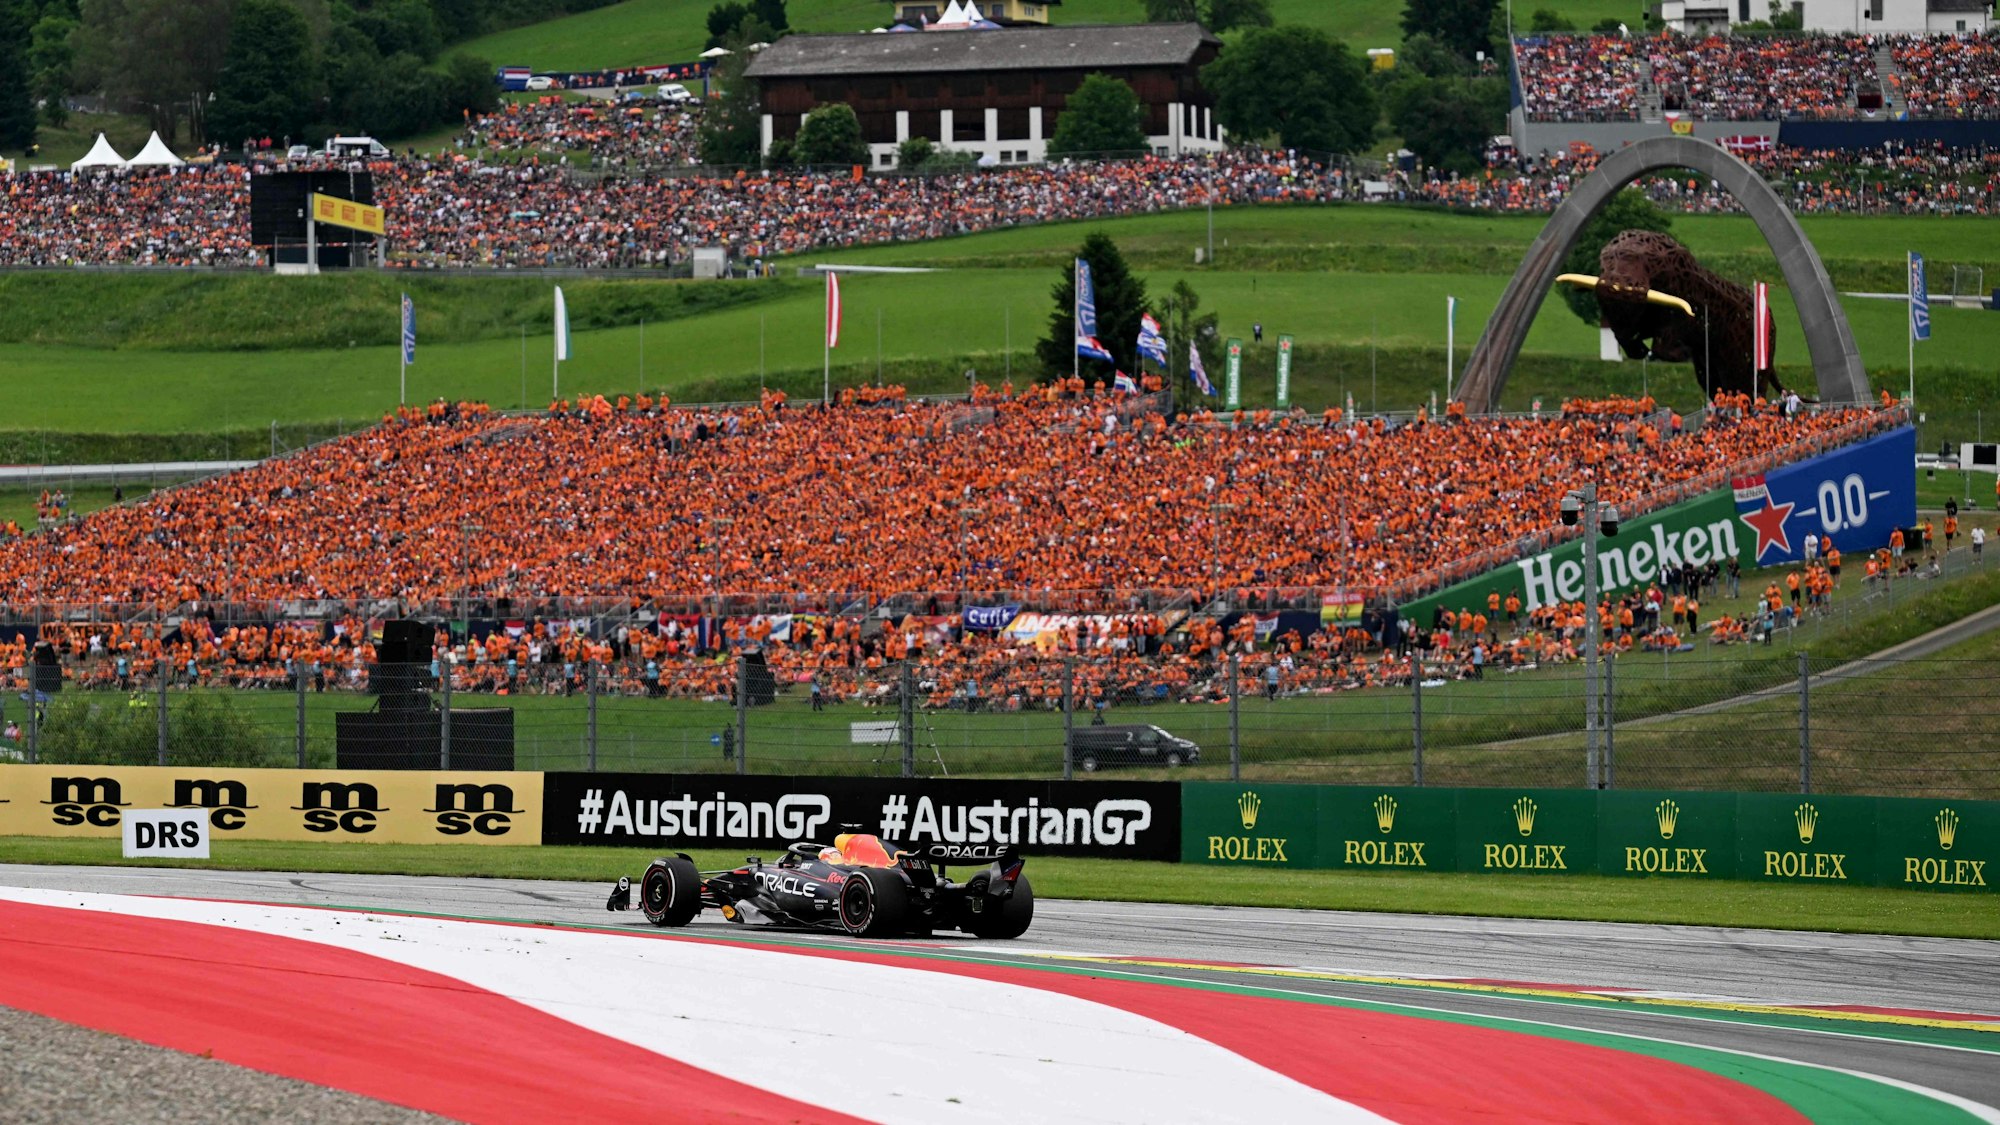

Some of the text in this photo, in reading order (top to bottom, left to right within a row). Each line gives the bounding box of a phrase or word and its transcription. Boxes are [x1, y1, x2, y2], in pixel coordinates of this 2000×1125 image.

[578, 789, 1152, 846] #AustrianGP #AustrianGP
[135, 820, 200, 849] DRS
[929, 844, 1008, 858] ORACLE
[1208, 836, 1287, 862] ROLEX
[1344, 840, 1425, 866] ROLEX
[1484, 844, 1567, 870] ROLEX
[1626, 847, 1708, 874] ROLEX
[1765, 851, 1846, 880] ROLEX
[1905, 857, 1986, 886] ROLEX
[754, 871, 821, 898] ORACLE
